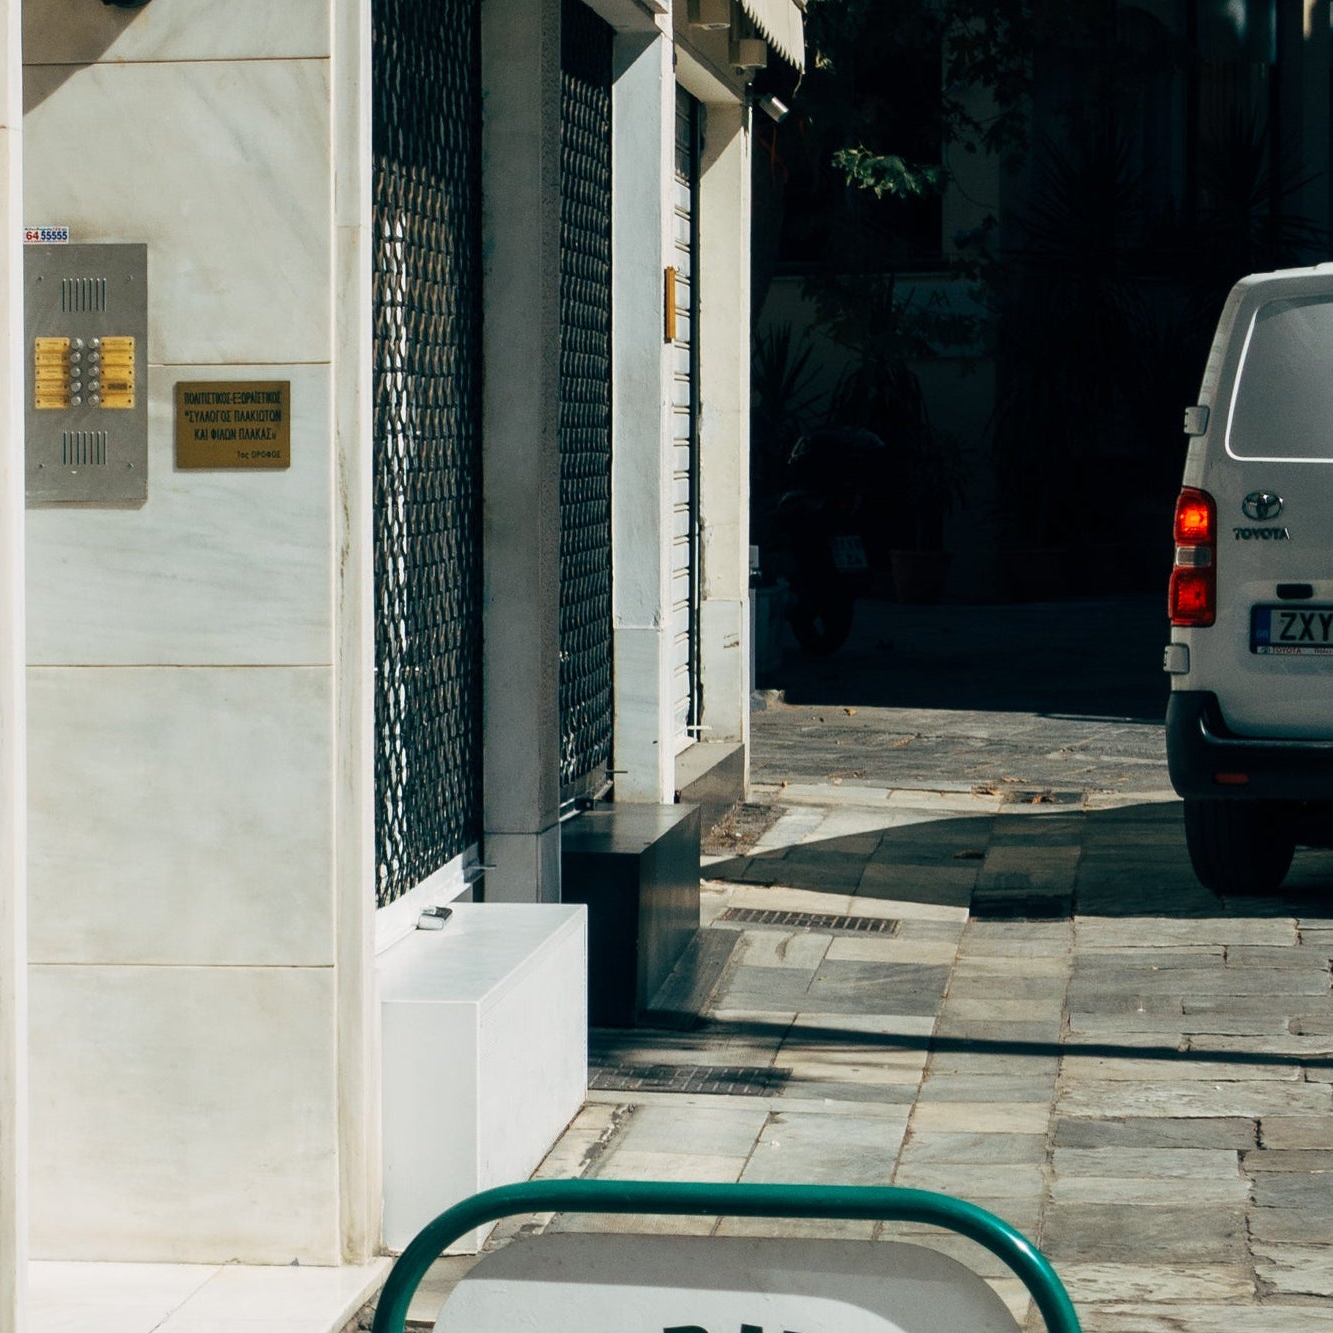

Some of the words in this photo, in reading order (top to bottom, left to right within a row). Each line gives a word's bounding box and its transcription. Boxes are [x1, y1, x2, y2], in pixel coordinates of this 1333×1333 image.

[25, 230, 40, 241] 64
[40, 230, 68, 241] 55555
[194, 428, 208, 441] ΚΑΙ
[210, 428, 237, 441] ΦΙΛΩΝ
[250, 450, 282, 459] ΟΡΟΦΟΣ
[1233, 527, 1291, 541] TOYOTA
